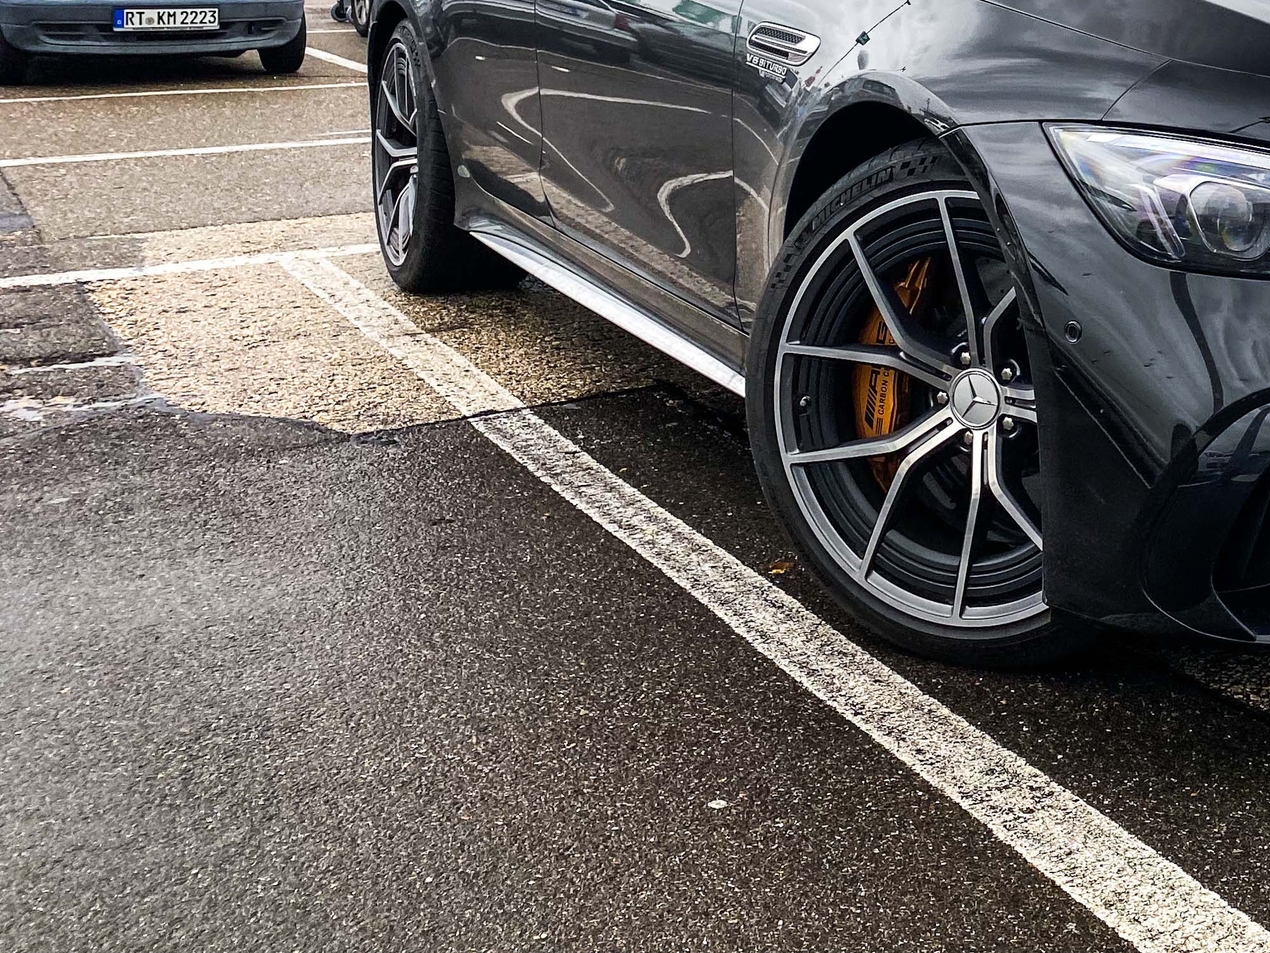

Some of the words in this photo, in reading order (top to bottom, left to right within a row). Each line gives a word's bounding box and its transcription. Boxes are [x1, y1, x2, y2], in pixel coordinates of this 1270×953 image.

[125, 11, 145, 26] RT
[157, 11, 176, 25] KM
[180, 10, 217, 25] 2223
[746, 52, 760, 65] V8
[810, 165, 895, 232] MICHELIN
[877, 379, 890, 416] CARBON
